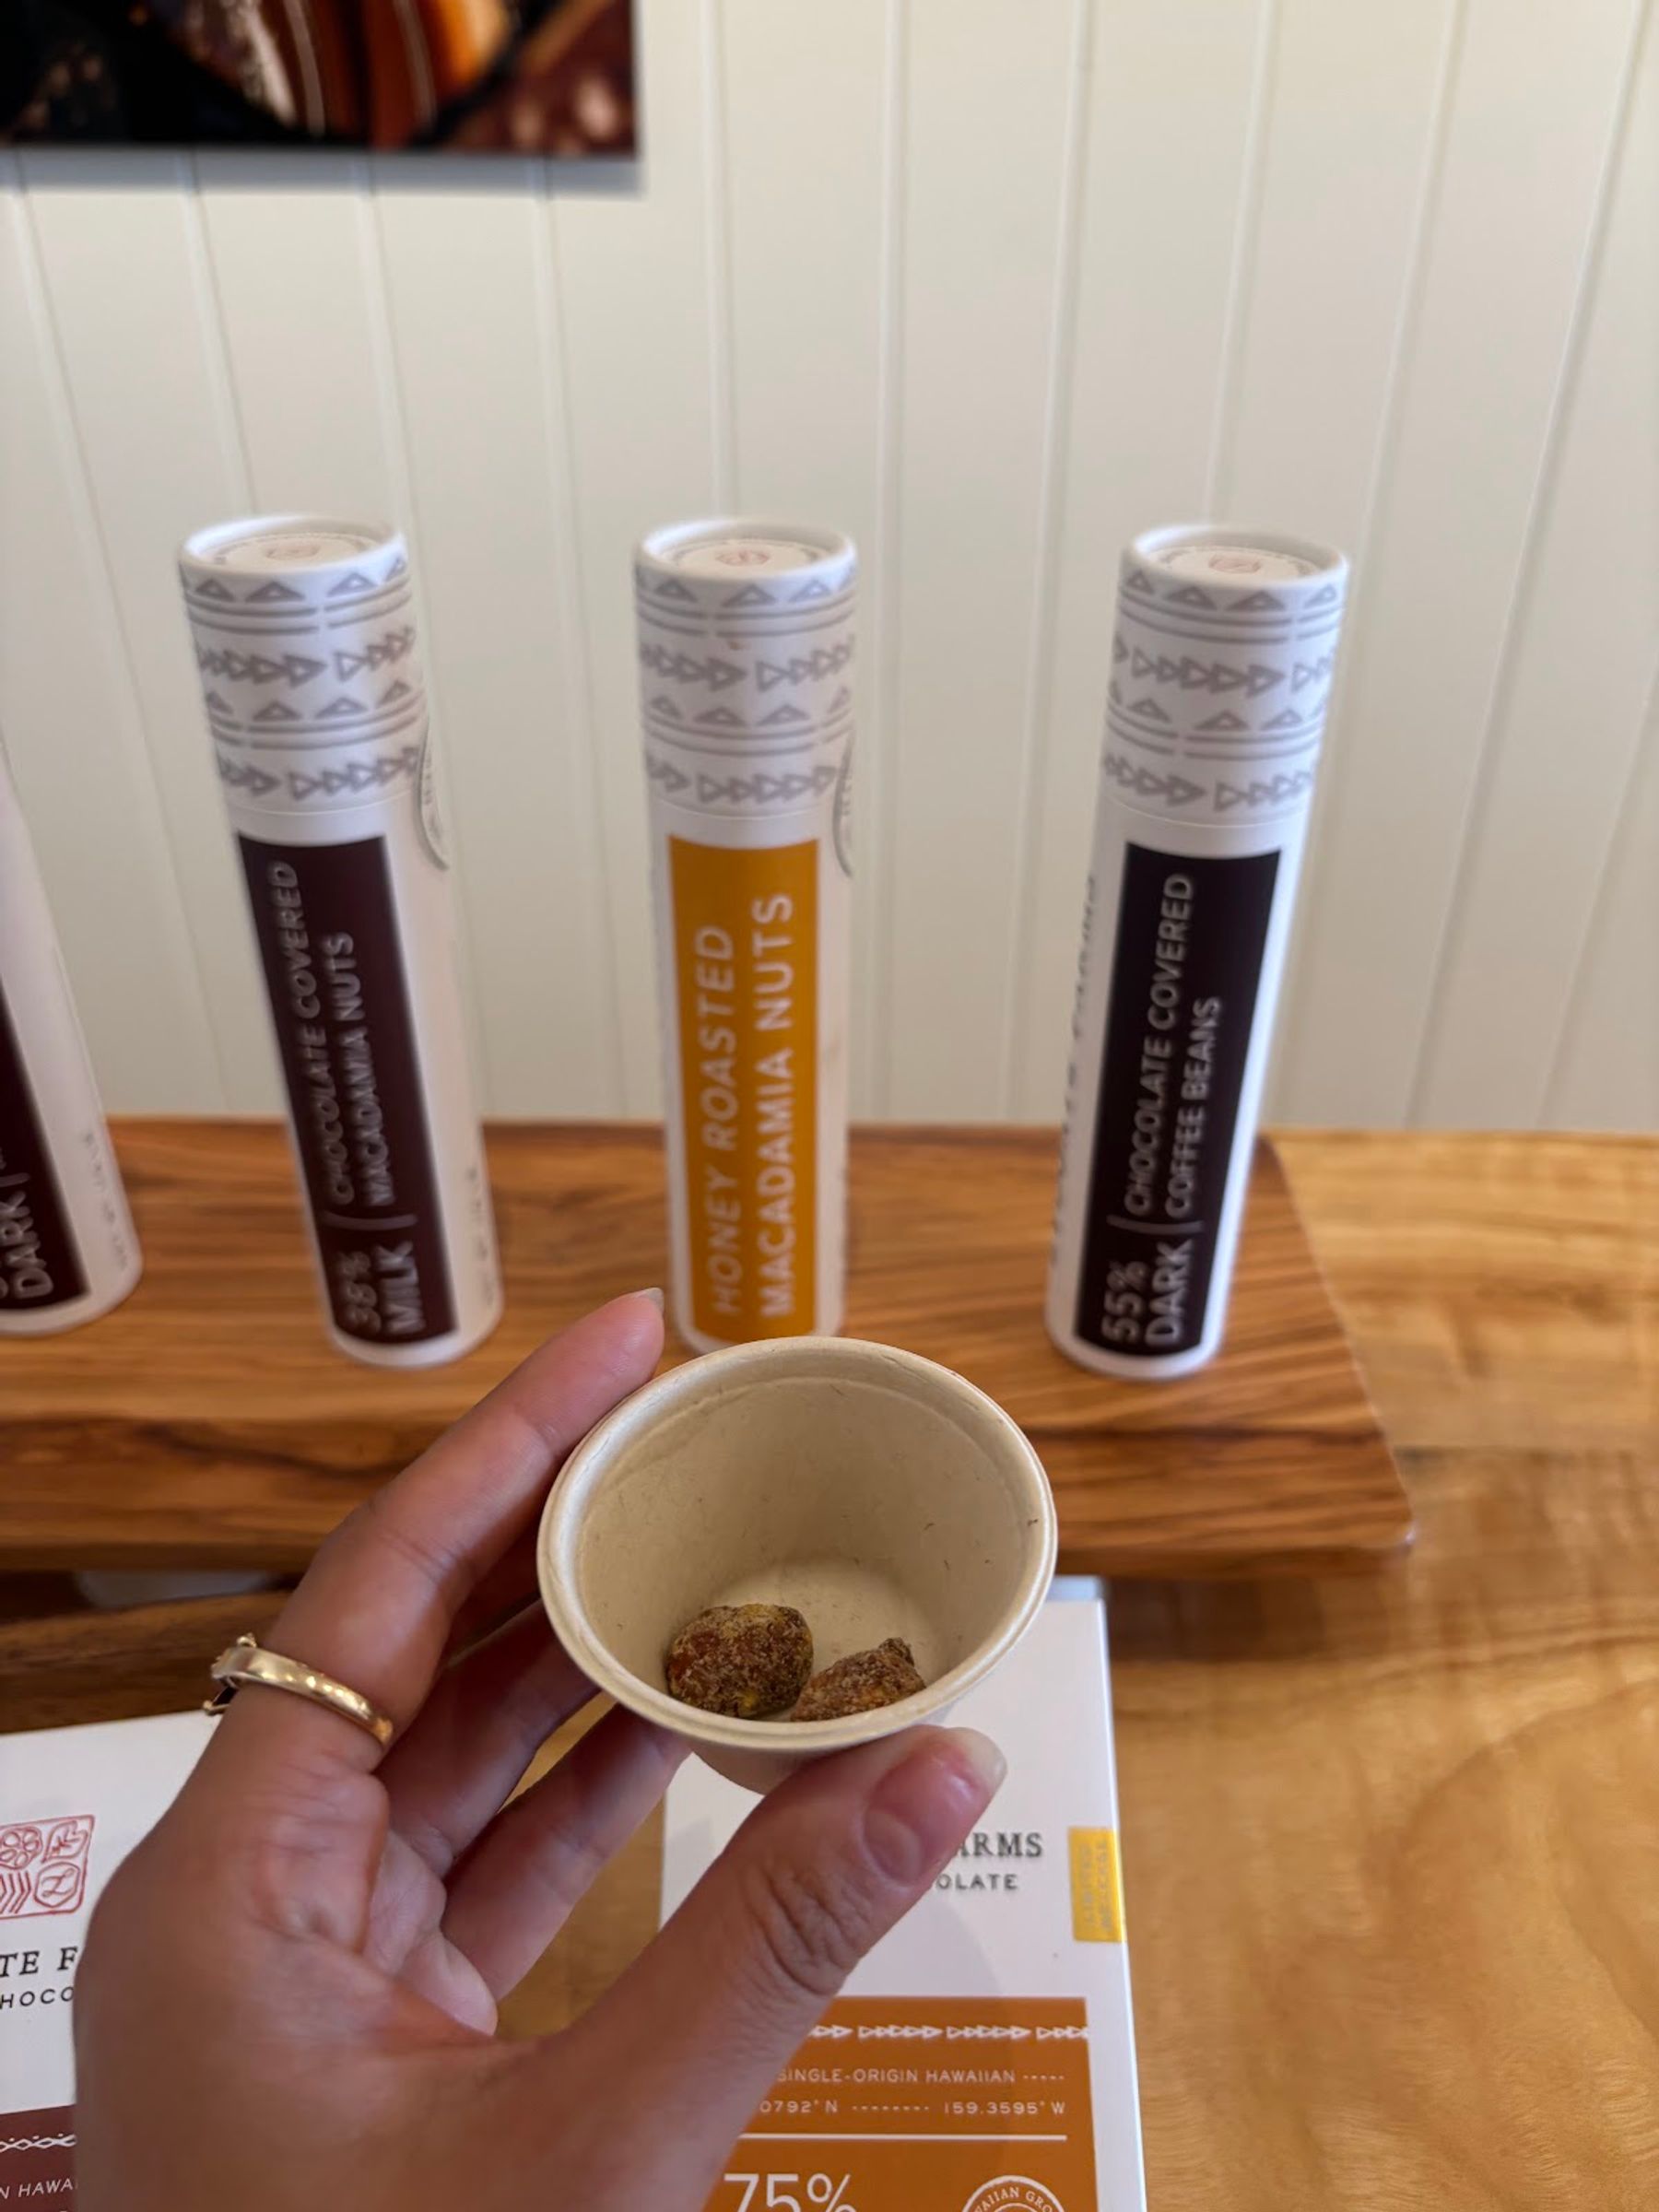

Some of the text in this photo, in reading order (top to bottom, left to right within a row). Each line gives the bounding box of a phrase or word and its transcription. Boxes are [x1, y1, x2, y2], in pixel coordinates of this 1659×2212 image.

[266, 861, 321, 1019] COVERED
[323, 931, 364, 1021] NUTS
[1124, 873, 1194, 1217] CHOCOLATE COVERED
[695, 924, 740, 1316] HONEY ROASTED
[752, 892, 794, 1318] MACADAMIA NUTS
[1166, 996, 1220, 1218] COFFEE BEANS
[376, 1240, 426, 1335] MILK
[1101, 1260, 1149, 1343] 55%
[1146, 1238, 1193, 1347] DARK
[935, 1873, 1018, 1890] OLATE
[759, 2100, 838, 2113] 0792° N
[925, 2070, 1015, 2083] HAWAIIAN
[1051, 2101, 1065, 2114] W
[724, 2172, 856, 2212] 75%
